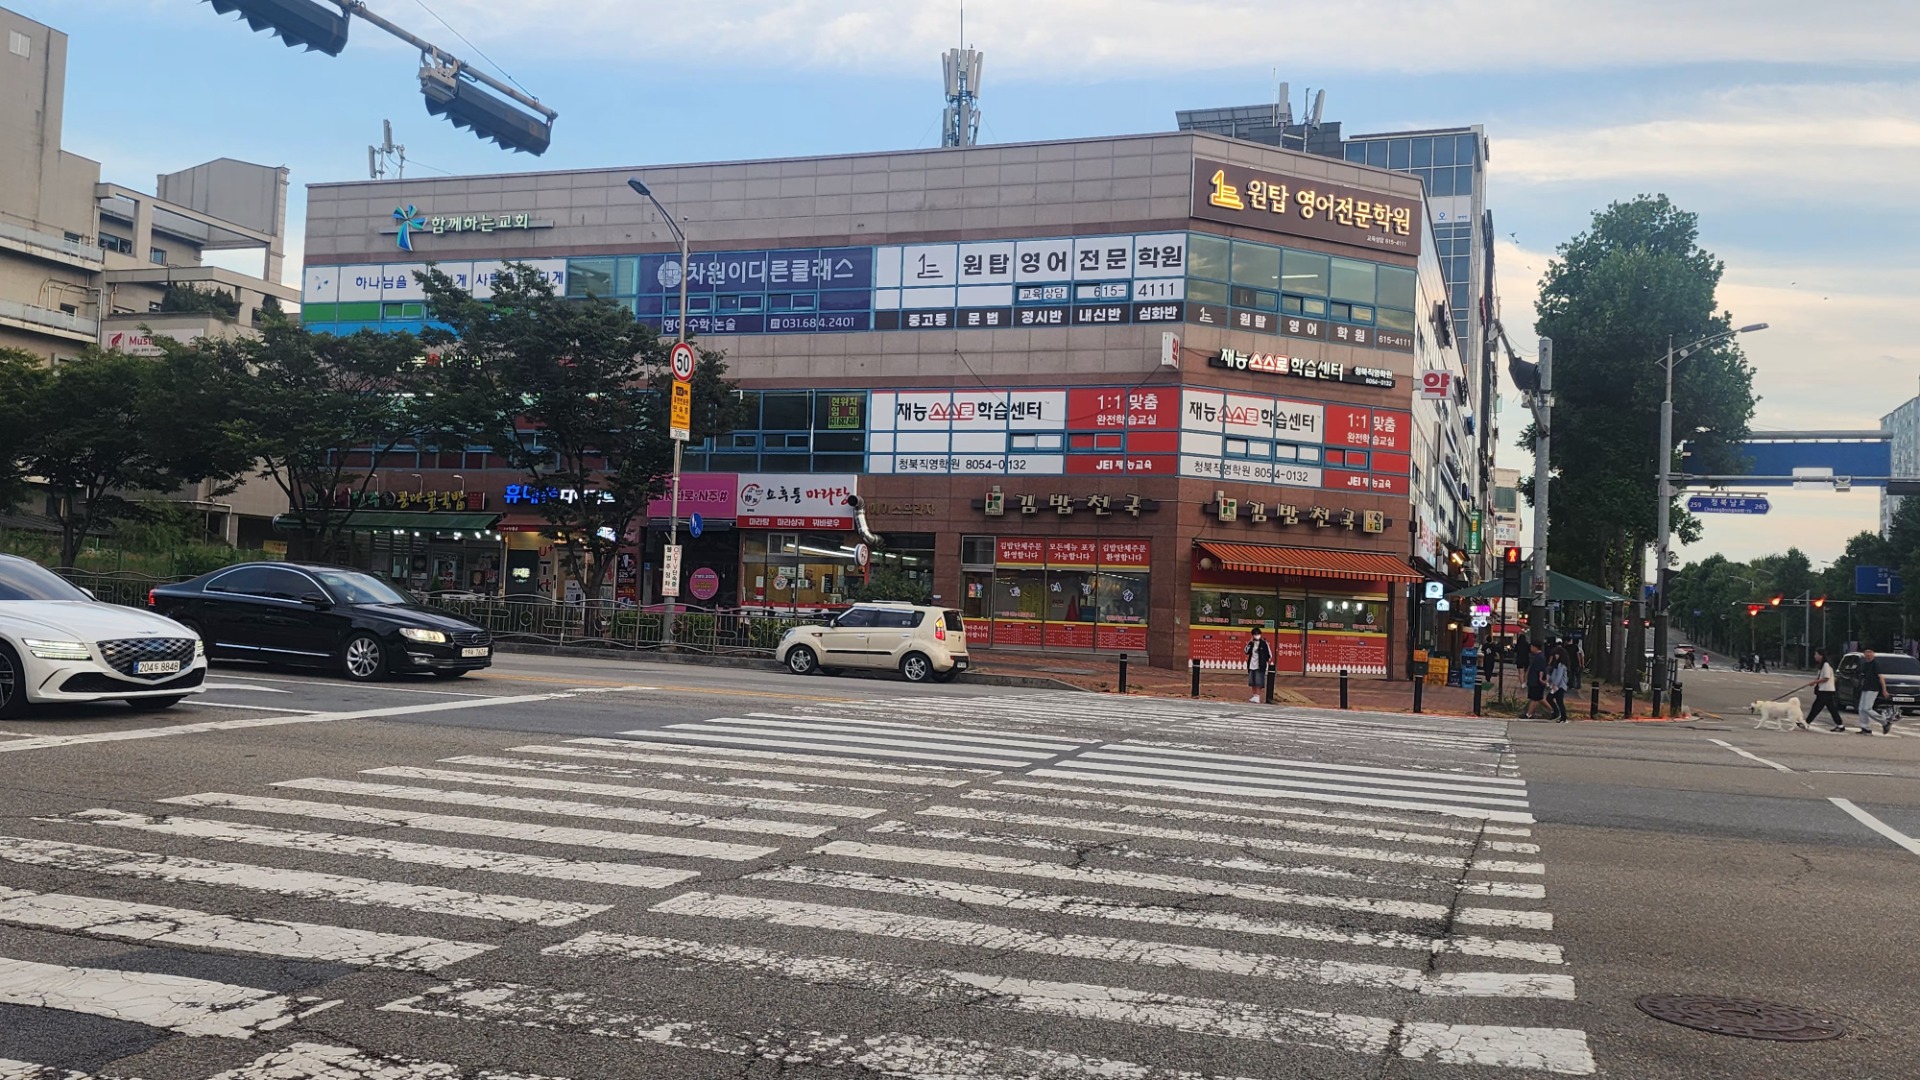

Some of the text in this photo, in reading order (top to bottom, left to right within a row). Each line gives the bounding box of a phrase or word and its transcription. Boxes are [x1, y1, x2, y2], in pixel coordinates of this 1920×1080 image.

[1247, 180, 1411, 235] 원탑 영어전문학원
[431, 213, 530, 234] 함께하는교회
[963, 244, 1183, 276] 원탑 영어 전문 학원
[356, 275, 408, 290] 하나님을
[1022, 287, 1064, 300] 교육상담
[908, 313, 948, 327] 중고등
[1021, 309, 1063, 324] 정시반
[1079, 307, 1122, 322] 내신반
[1138, 305, 1178, 320] 심화반
[1239, 312, 1412, 347] 원탑 영어 학원 615-4111
[676, 353, 690, 373] 50
[1365, 377, 1392, 387] 8054-0132
[1423, 372, 1451, 397] 약
[1097, 393, 1159, 411] 1:1 맞춤
[1096, 414, 1157, 426] 완전학습교실
[1347, 413, 1396, 433] 1:1 맞춤
[1347, 432, 1395, 447] 완전학습교실
[898, 458, 1027, 471] 청북직영학원 8054-0132
[1096, 459, 1152, 471] JEI 재능교육
[1193, 461, 1309, 482] 청북직영학원 8054-0132
[1347, 476, 1361, 487] JEI
[805, 486, 852, 506] 마라탕
[1015, 493, 1143, 518] 김밥천국
[1690, 501, 1702, 509] 259
[1246, 498, 1356, 531] 김밥천국
[1000, 541, 1043, 551] 김밥단체주문
[1102, 544, 1147, 553] 김밥단체주문
[1003, 551, 1039, 560] 환영합니다
[1054, 552, 1091, 561] 가능합니다
[1105, 553, 1143, 562] 환영합니다
[160, 662, 179, 671] 8848
